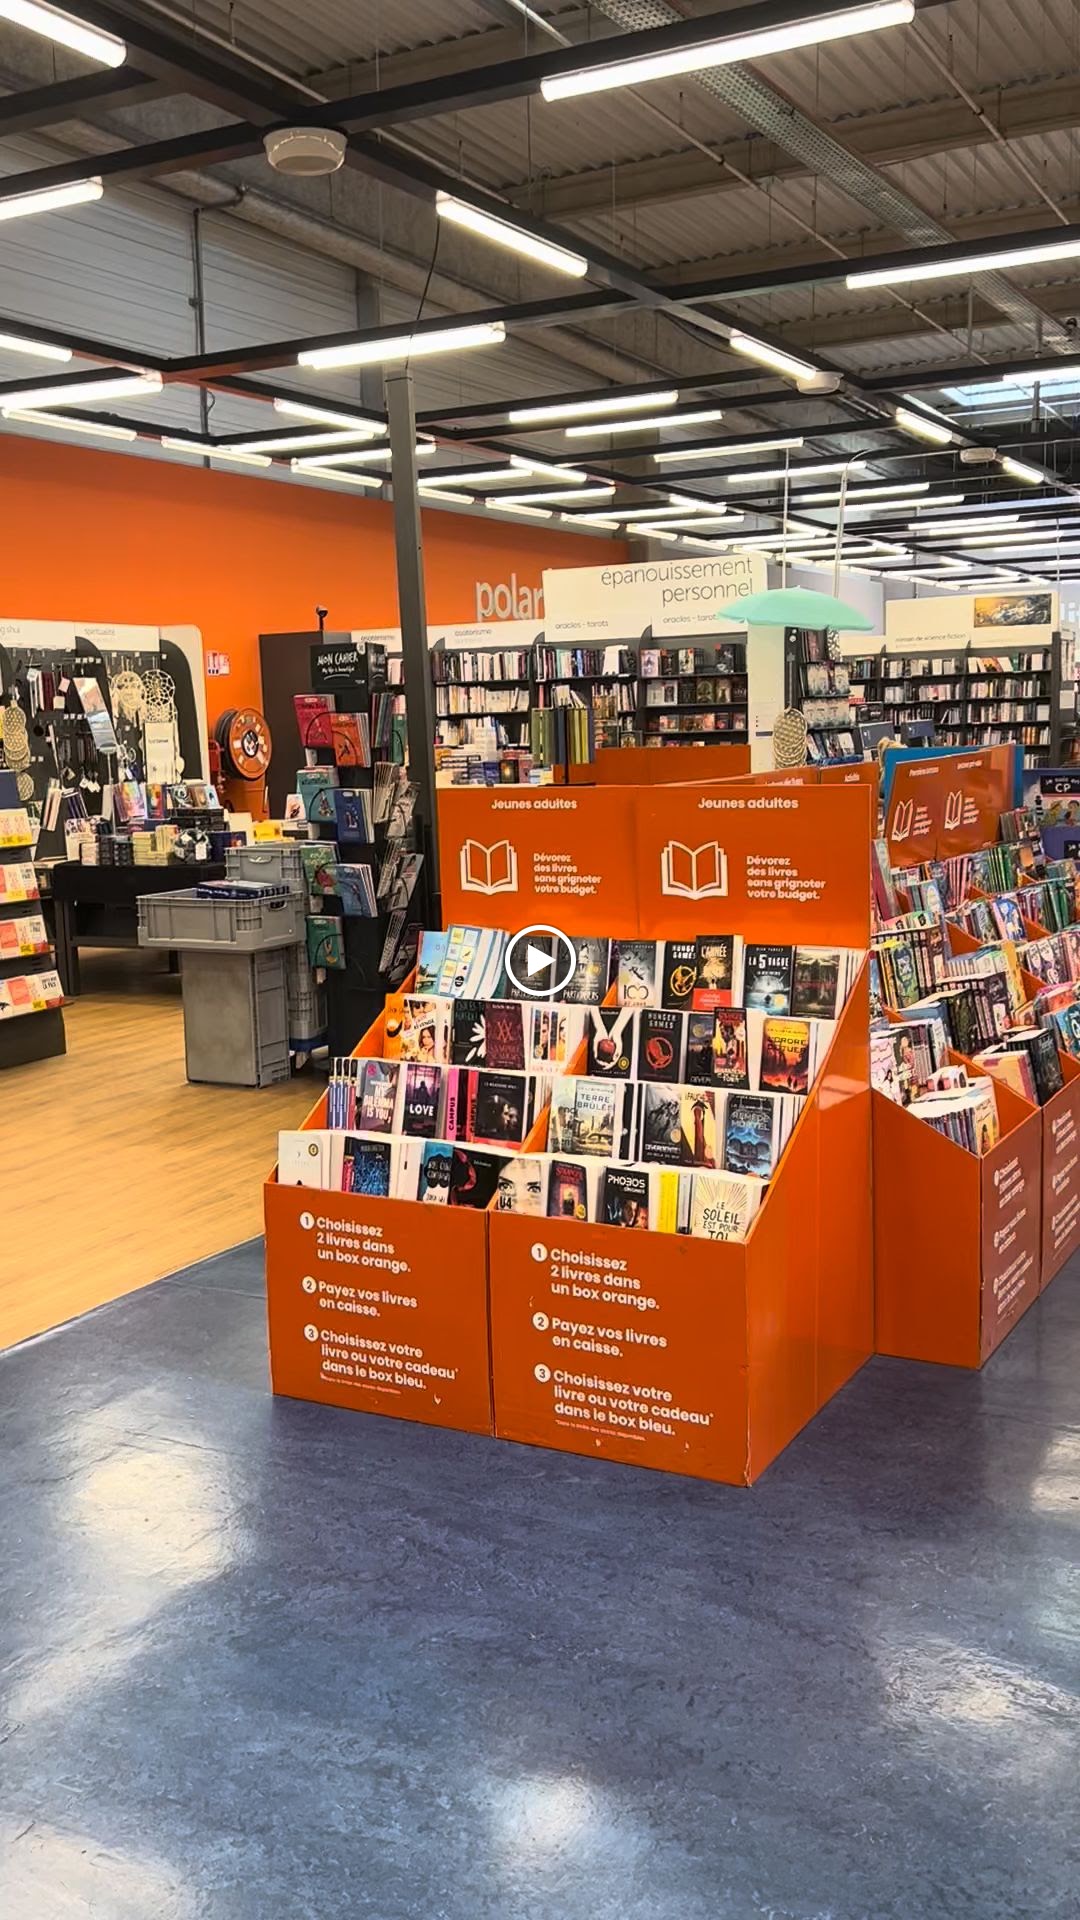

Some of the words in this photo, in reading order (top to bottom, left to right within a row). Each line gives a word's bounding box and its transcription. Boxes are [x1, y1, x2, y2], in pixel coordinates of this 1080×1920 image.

[601, 557, 752, 587] épanouissement
[475, 573, 544, 622] polar
[662, 578, 753, 608] personnel
[555, 620, 581, 630] oracles
[587, 620, 609, 628] tarots
[663, 615, 691, 624] oracles
[317, 652, 333, 666] MON
[1055, 783, 1071, 793] CP
[491, 799, 532, 810] Jeunes
[533, 798, 578, 810] adultes
[698, 798, 745, 809] Jeunes
[747, 797, 799, 809] adultes
[533, 852, 572, 862] Dévorez
[746, 855, 791, 866] Dévorez
[534, 863, 551, 872] des
[551, 863, 578, 873] livres
[747, 867, 766, 876] des
[768, 867, 798, 877] livres
[557, 874, 602, 886] grignoter
[747, 879, 773, 887] sans
[774, 878, 826, 890] grignoter
[535, 884, 560, 893] votre
[560, 884, 598, 896] budget.
[747, 889, 777, 898] votre
[777, 889, 821, 902] budget.
[648, 1013, 676, 1021] HUNGER
[649, 1020, 674, 1029] GAMES
[364, 1095, 394, 1110] DILEMMA
[581, 1093, 610, 1104] TERRE
[367, 1107, 374, 1117] IS
[409, 1104, 434, 1117] LOVE
[500, 1196, 512, 1210] U4
[716, 1201, 725, 1210] LE
[702, 1207, 740, 1225] SOLEIL
[316, 1216, 383, 1237] Choisissez
[703, 1220, 716, 1230] EST
[718, 1223, 738, 1233] POUR
[317, 1232, 324, 1244] 2
[326, 1232, 361, 1249] livres
[362, 1237, 395, 1254] dans
[317, 1250, 334, 1261] un
[336, 1251, 360, 1265] box
[361, 1256, 411, 1274] orange.
[550, 1248, 628, 1271] Choisissez
[550, 1265, 560, 1277] 2
[561, 1266, 601, 1284] livres
[603, 1273, 641, 1290] dans
[318, 1281, 355, 1299] Payez
[358, 1288, 380, 1301] vos
[382, 1290, 418, 1308] livres
[551, 1282, 570, 1295] un
[572, 1283, 600, 1300] box
[602, 1291, 660, 1311] orange.
[319, 1298, 335, 1310] en
[337, 1301, 381, 1317] caisse.
[552, 1317, 595, 1337] Payez
[597, 1327, 623, 1341] vos
[625, 1328, 668, 1348] livres
[320, 1329, 387, 1352] Choisissez
[388, 1342, 423, 1358] votre
[552, 1336, 571, 1348] en
[573, 1337, 624, 1357] caisse.
[321, 1344, 349, 1360] livre
[351, 1352, 367, 1363] ou
[369, 1354, 403, 1370] votre
[322, 1360, 354, 1375] dans
[355, 1366, 367, 1378] le
[369, 1367, 393, 1384] box
[394, 1373, 427, 1389] bleu.
[553, 1370, 630, 1395] Choisissez
[632, 1384, 673, 1402] votre
[554, 1385, 586, 1402] livre
[588, 1393, 607, 1407] ou
[609, 1396, 649, 1414] votre
[555, 1401, 591, 1420] dans
[593, 1409, 606, 1423] le
[609, 1411, 637, 1429] box
[638, 1417, 676, 1436] bleu.
